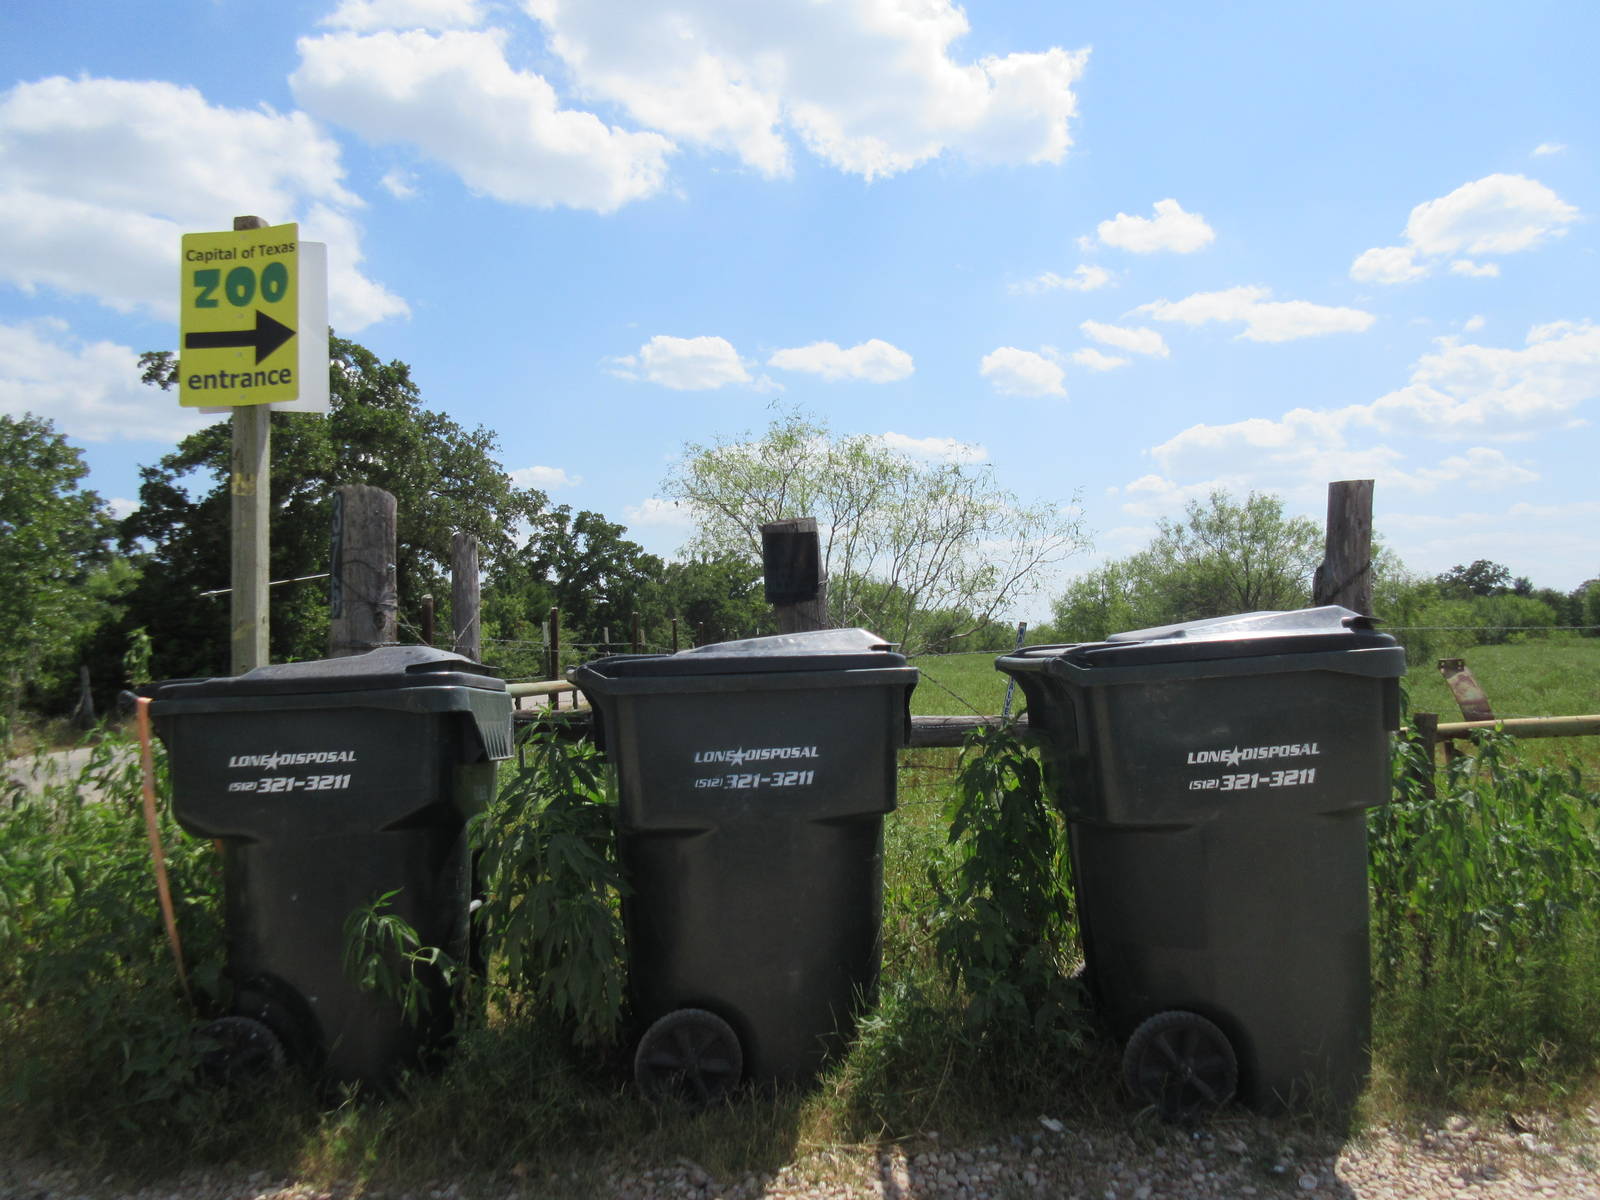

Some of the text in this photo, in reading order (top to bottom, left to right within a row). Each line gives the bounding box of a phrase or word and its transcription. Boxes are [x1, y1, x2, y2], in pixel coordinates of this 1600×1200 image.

[186, 242, 296, 263] Capital of Texas
[188, 368, 292, 390] entrance
[228, 751, 357, 768] LONE DISPOSAL
[694, 746, 820, 763] LONE DISPOSAL
[1187, 743, 1321, 764] LONE DISPOSAL
[256, 774, 351, 793] 321-3211
[695, 770, 815, 789] (512) 321-3211
[1189, 768, 1316, 791] (512) 321-3211
